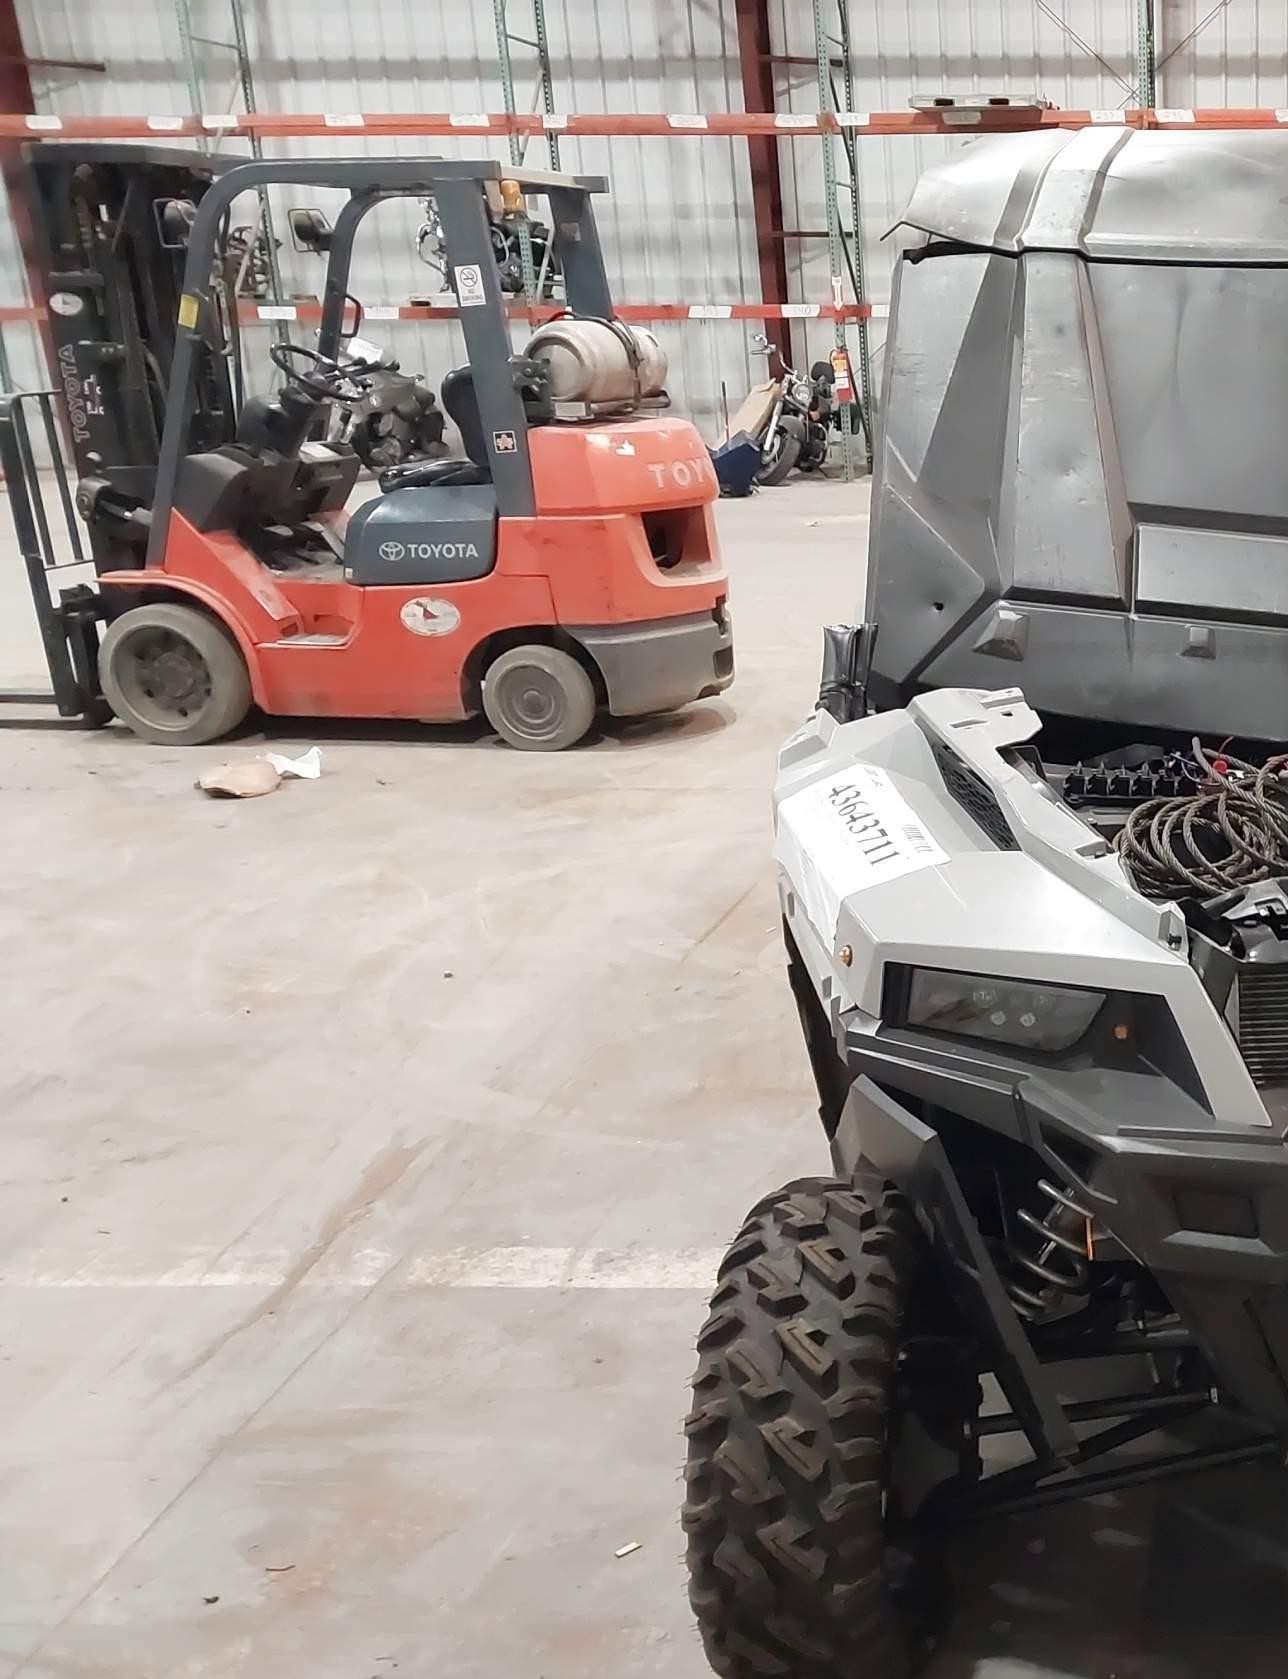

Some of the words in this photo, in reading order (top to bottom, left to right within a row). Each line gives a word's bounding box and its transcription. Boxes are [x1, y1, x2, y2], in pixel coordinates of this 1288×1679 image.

[58, 343, 91, 444] TOYOTA
[407, 543, 479, 559] TOYOTA
[828, 784, 901, 867] 43643711
